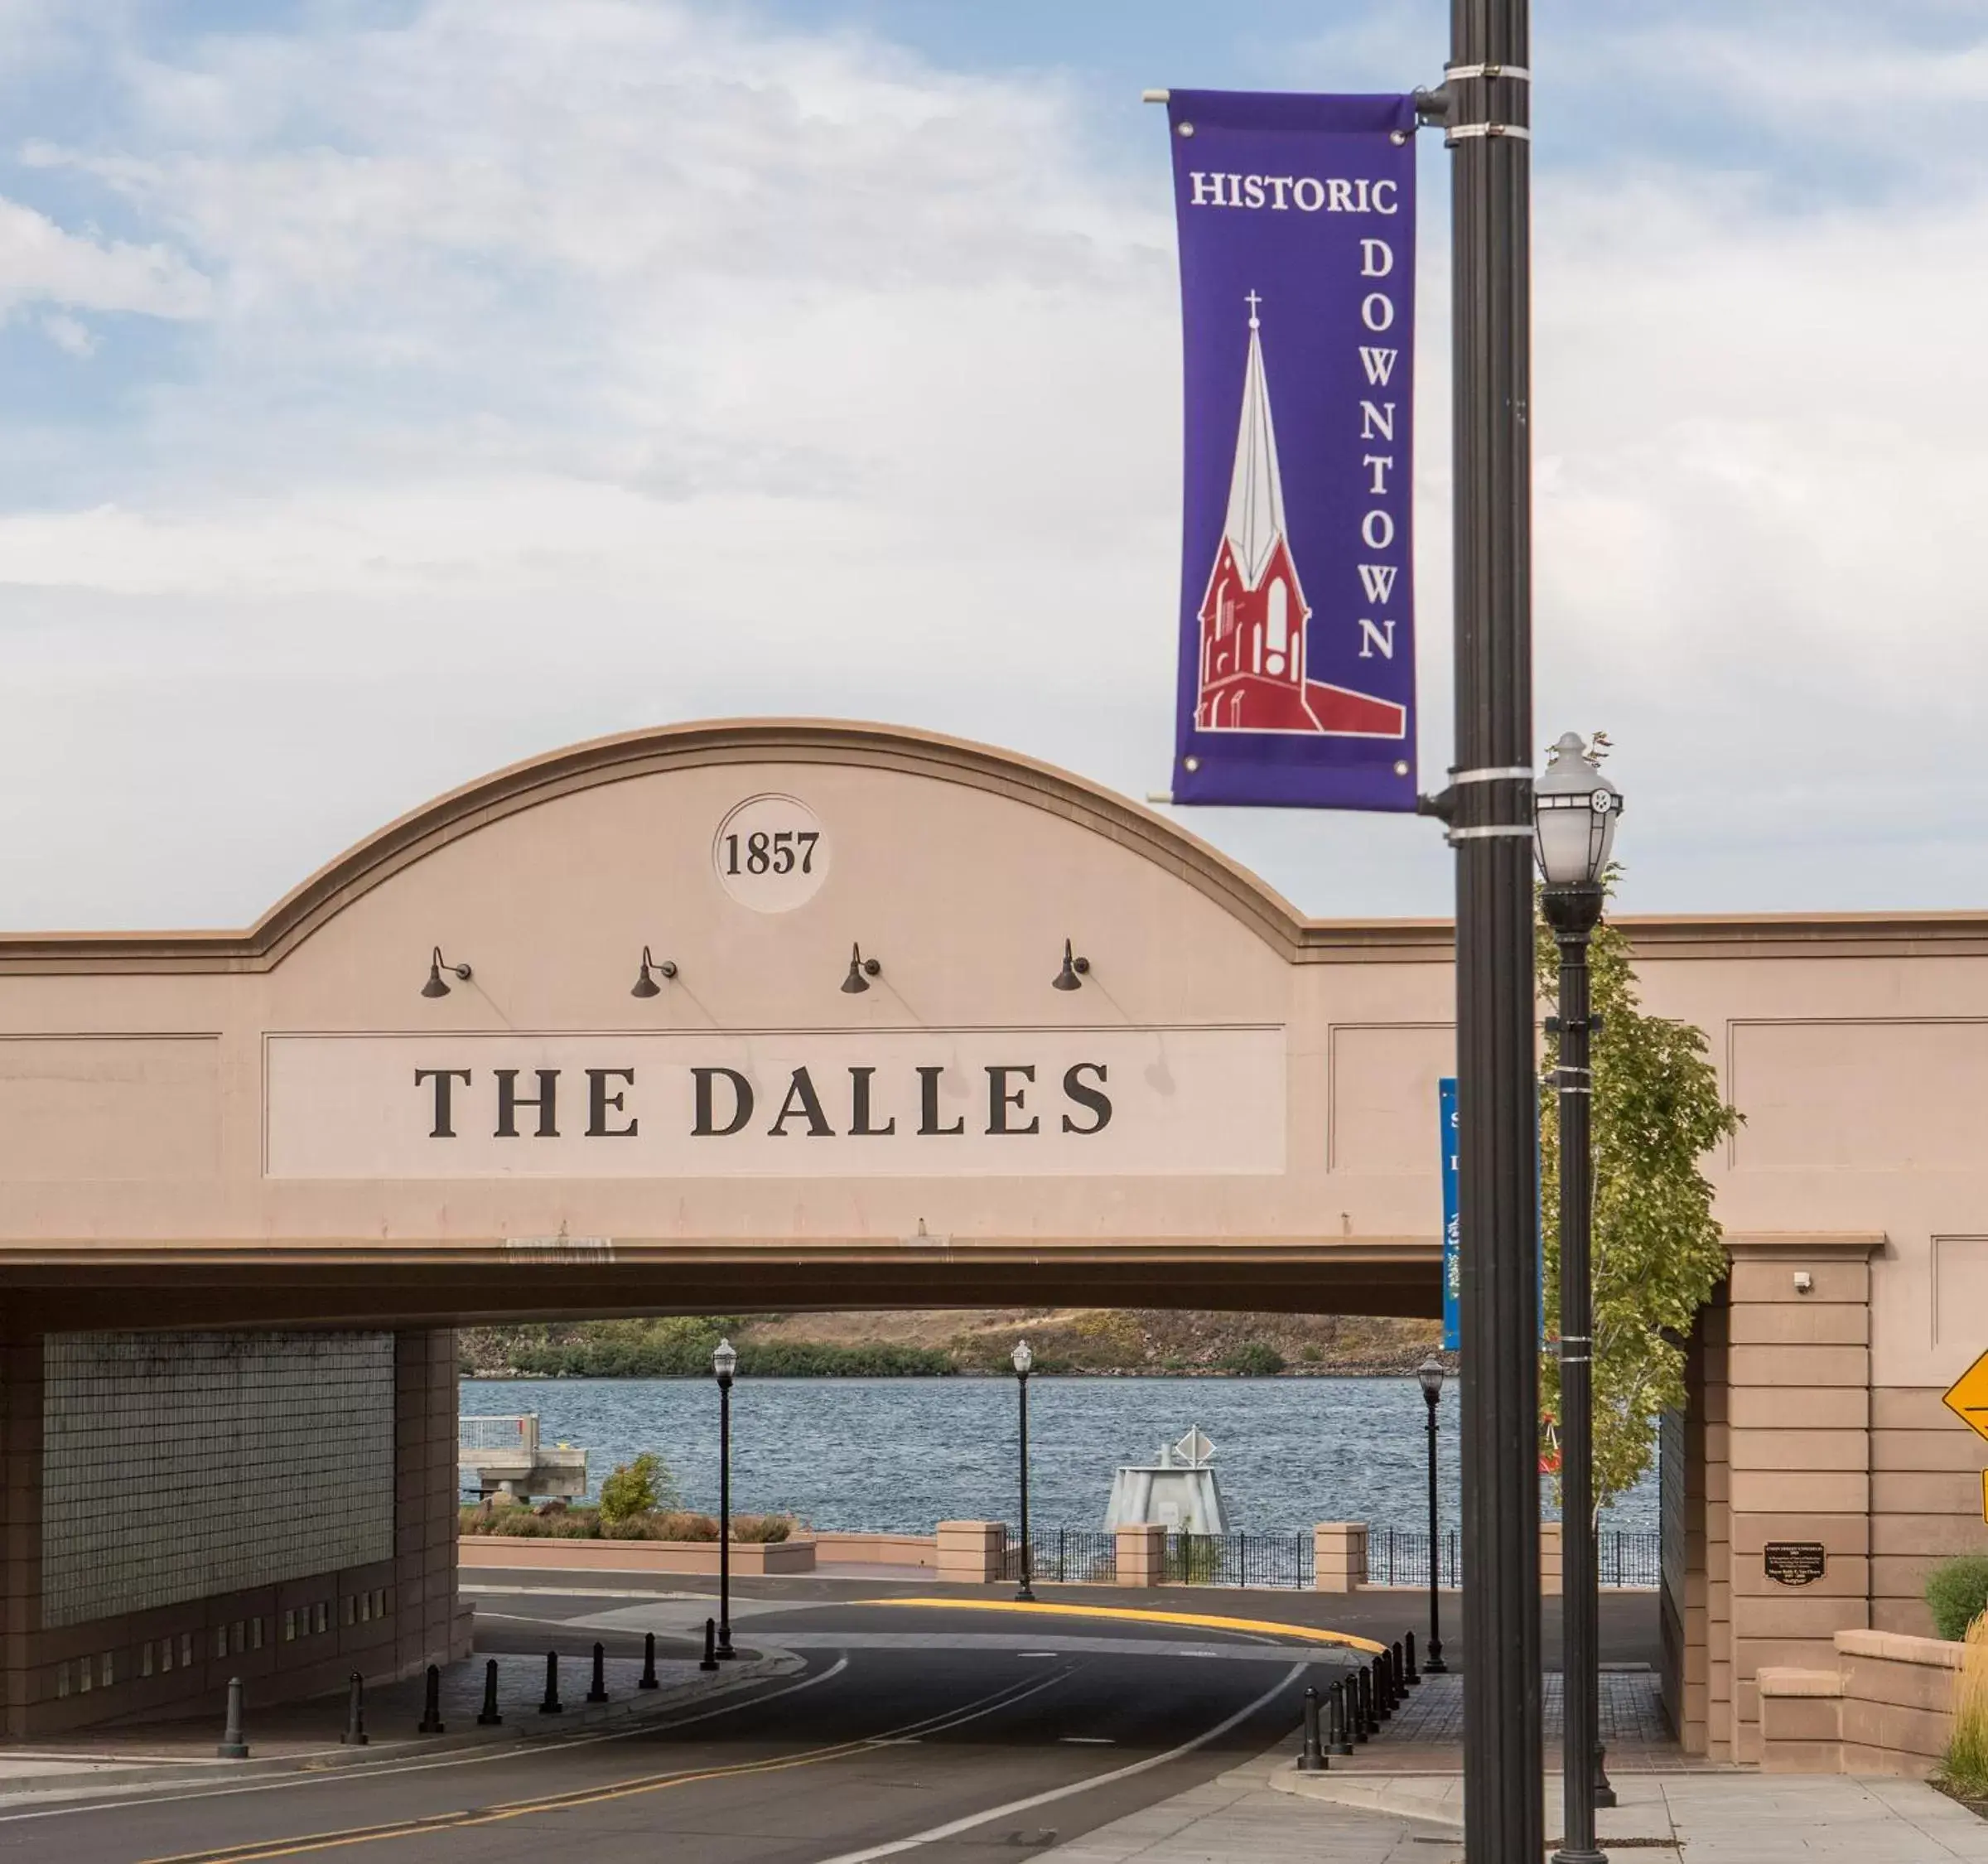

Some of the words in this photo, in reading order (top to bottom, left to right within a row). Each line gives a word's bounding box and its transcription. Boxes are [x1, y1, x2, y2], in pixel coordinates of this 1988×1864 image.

[1189, 171, 1398, 215] HISTORIC
[1358, 238, 1398, 660] DOWNTOWN
[726, 831, 820, 876] 1857
[415, 1068, 638, 1138] THE
[690, 1063, 1112, 1137] DALLES
